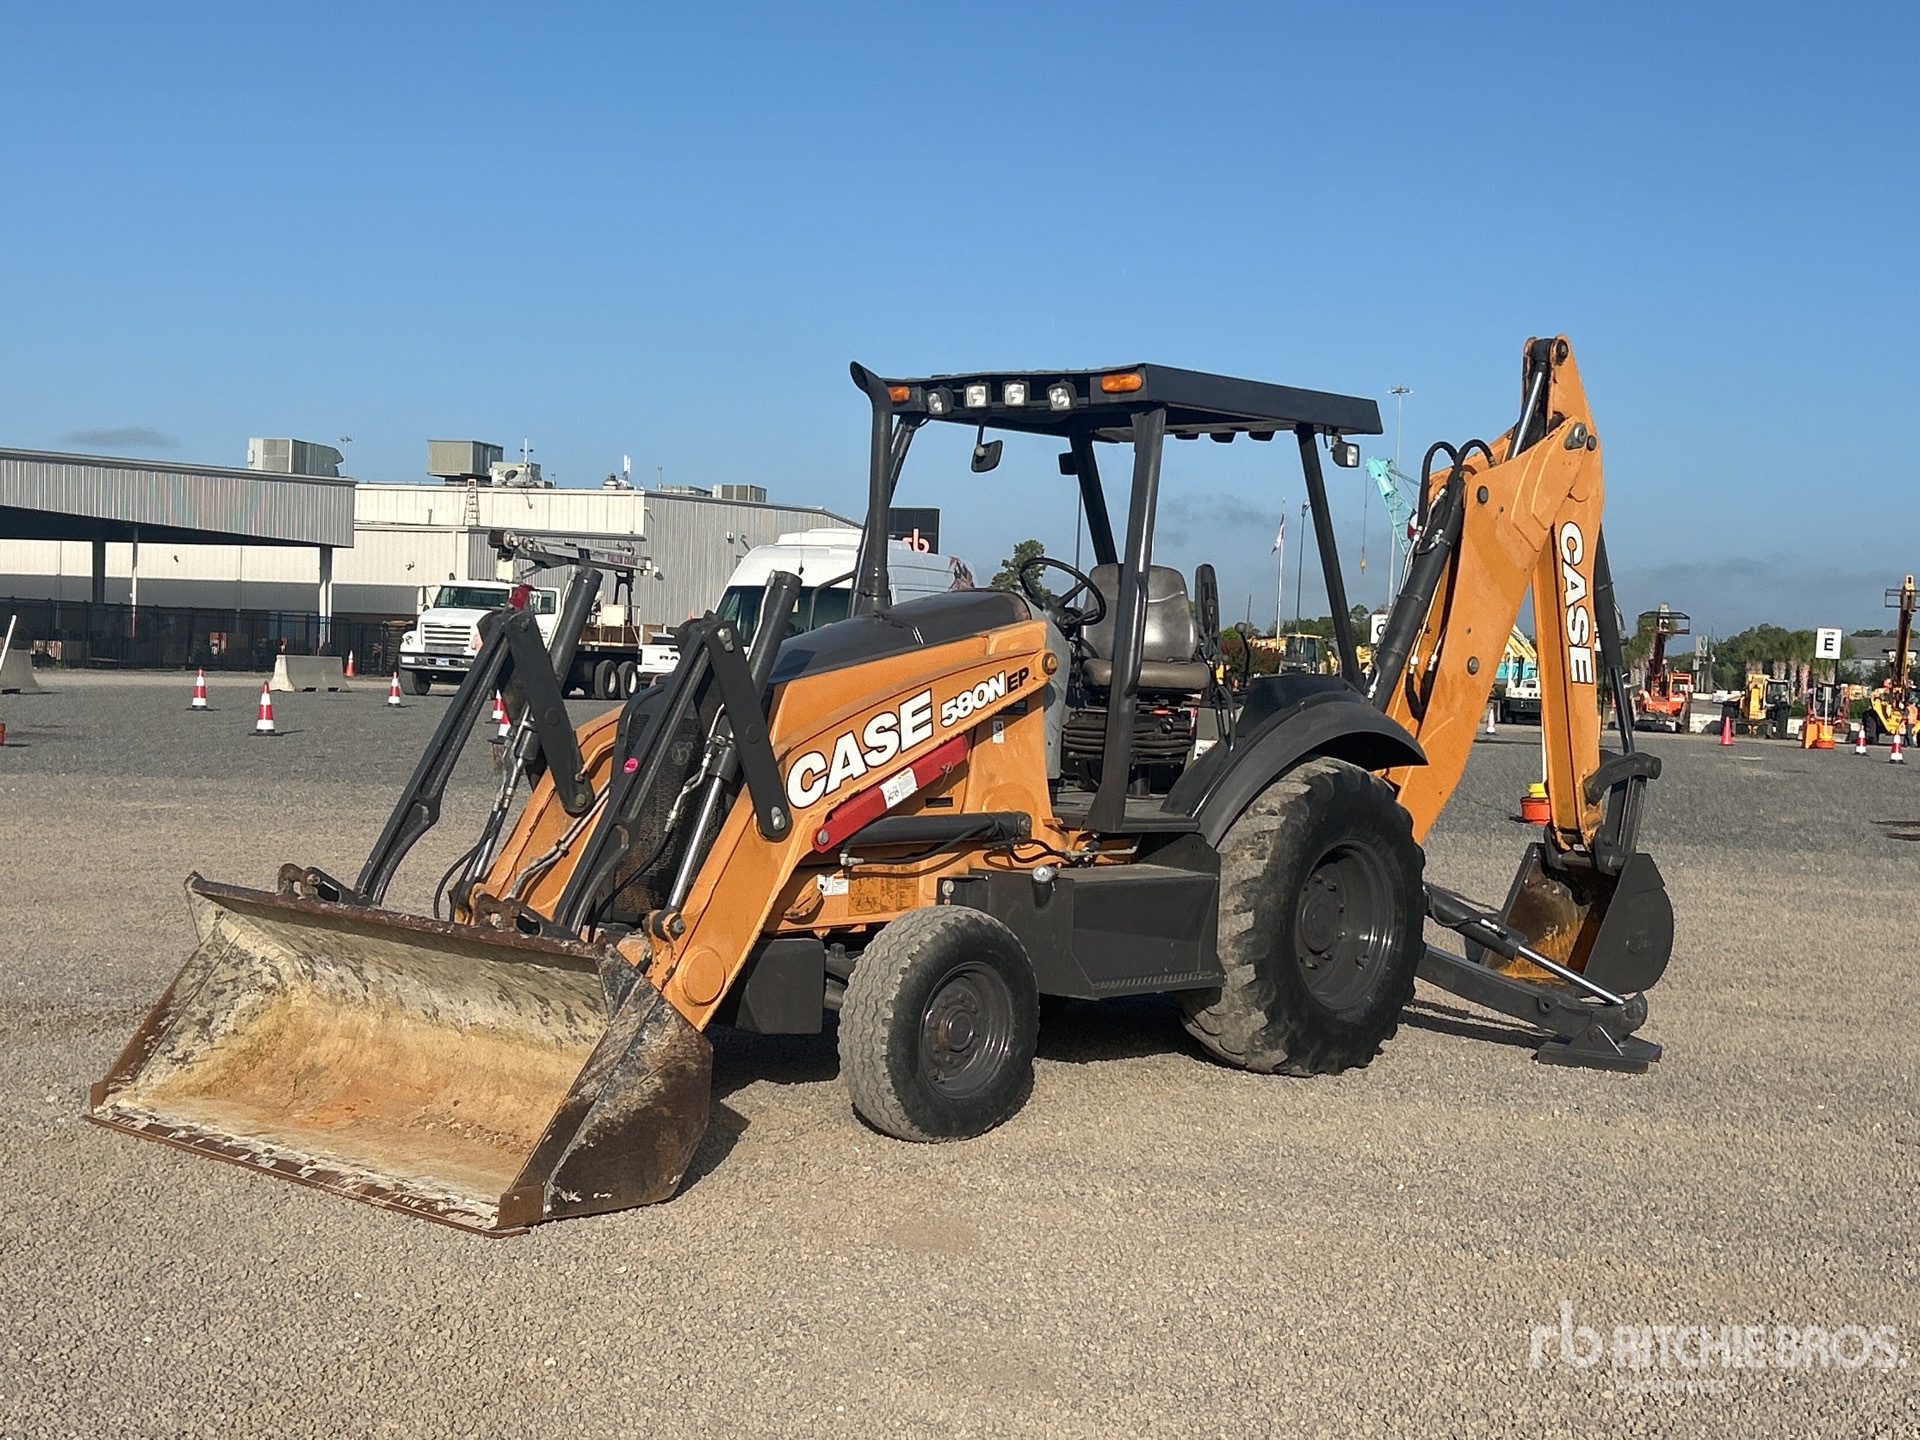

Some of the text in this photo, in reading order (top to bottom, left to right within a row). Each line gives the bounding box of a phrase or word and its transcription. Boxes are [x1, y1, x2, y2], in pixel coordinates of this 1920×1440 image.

[1559, 521, 1594, 684] CASE
[1823, 637, 1835, 651] E
[786, 667, 1030, 809] CASE 580N EP
